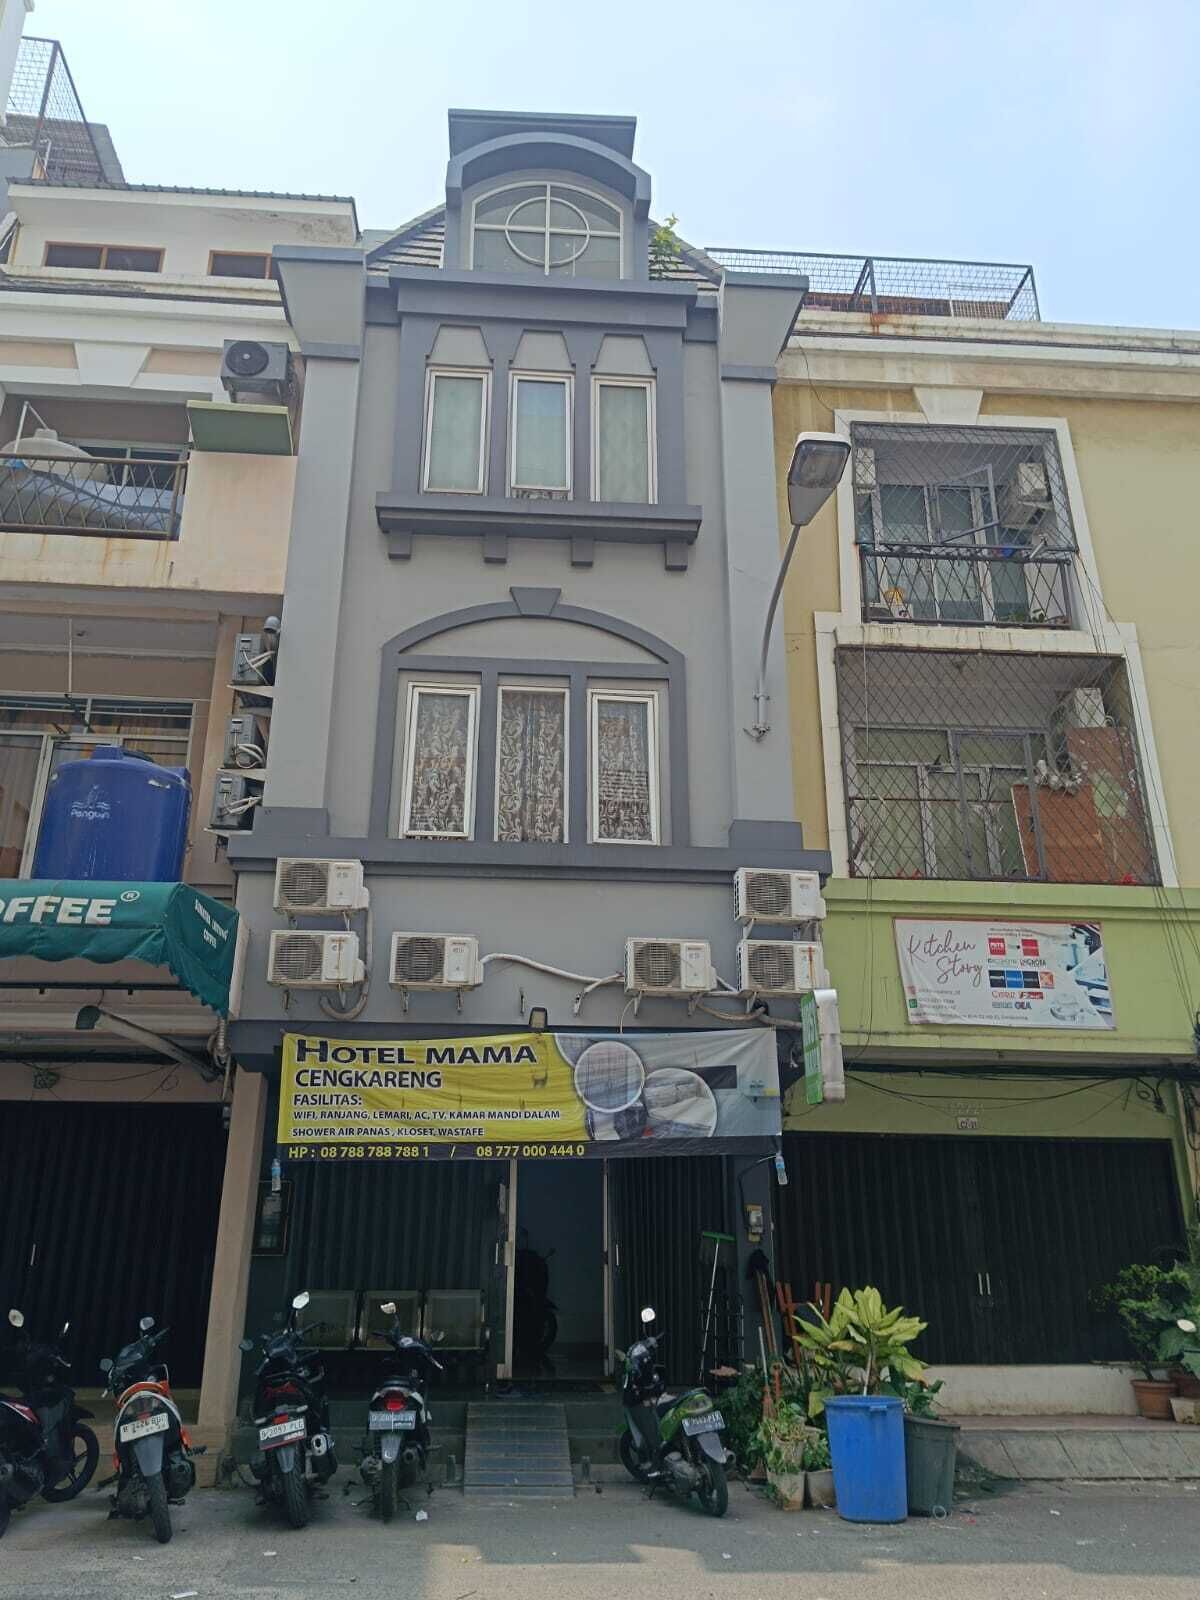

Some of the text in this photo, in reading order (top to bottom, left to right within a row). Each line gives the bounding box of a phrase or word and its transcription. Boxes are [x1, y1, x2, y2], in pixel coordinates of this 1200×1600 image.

[0, 896, 118, 925] FFEE
[907, 929, 976, 966] Kitchen
[936, 953, 983, 988] Story
[296, 1039, 537, 1065] HOTEL MAMA
[295, 1069, 442, 1088] CENGKARENG
[293, 1094, 362, 1106] FASILITAS:
[293, 1111, 318, 1120] WIFI,
[320, 1110, 371, 1120] RANJANG,
[373, 1110, 412, 1120] LEMARI,
[414, 1111, 430, 1120] AC,
[449, 1111, 488, 1119] KAMAR
[488, 1111, 522, 1119] MANDI
[524, 1110, 560, 1119] DALAM
[292, 1127, 338, 1137] SHOWER
[339, 1128, 355, 1136] AIR
[357, 1128, 390, 1136] PANAS
[438, 1127, 484, 1136] WASTAFE
[288, 1147, 308, 1158] HP
[320, 1147, 337, 1158] 08
[341, 1147, 364, 1157] 788
[368, 1147, 392, 1157] 788
[395, 1147, 419, 1157] 788
[423, 1147, 429, 1157] 1
[450, 1146, 456, 1158] /
[476, 1146, 492, 1157] 08
[496, 1146, 519, 1156] 777
[523, 1145, 546, 1156] 000
[550, 1145, 573, 1156] 444
[576, 1145, 585, 1155] 0
